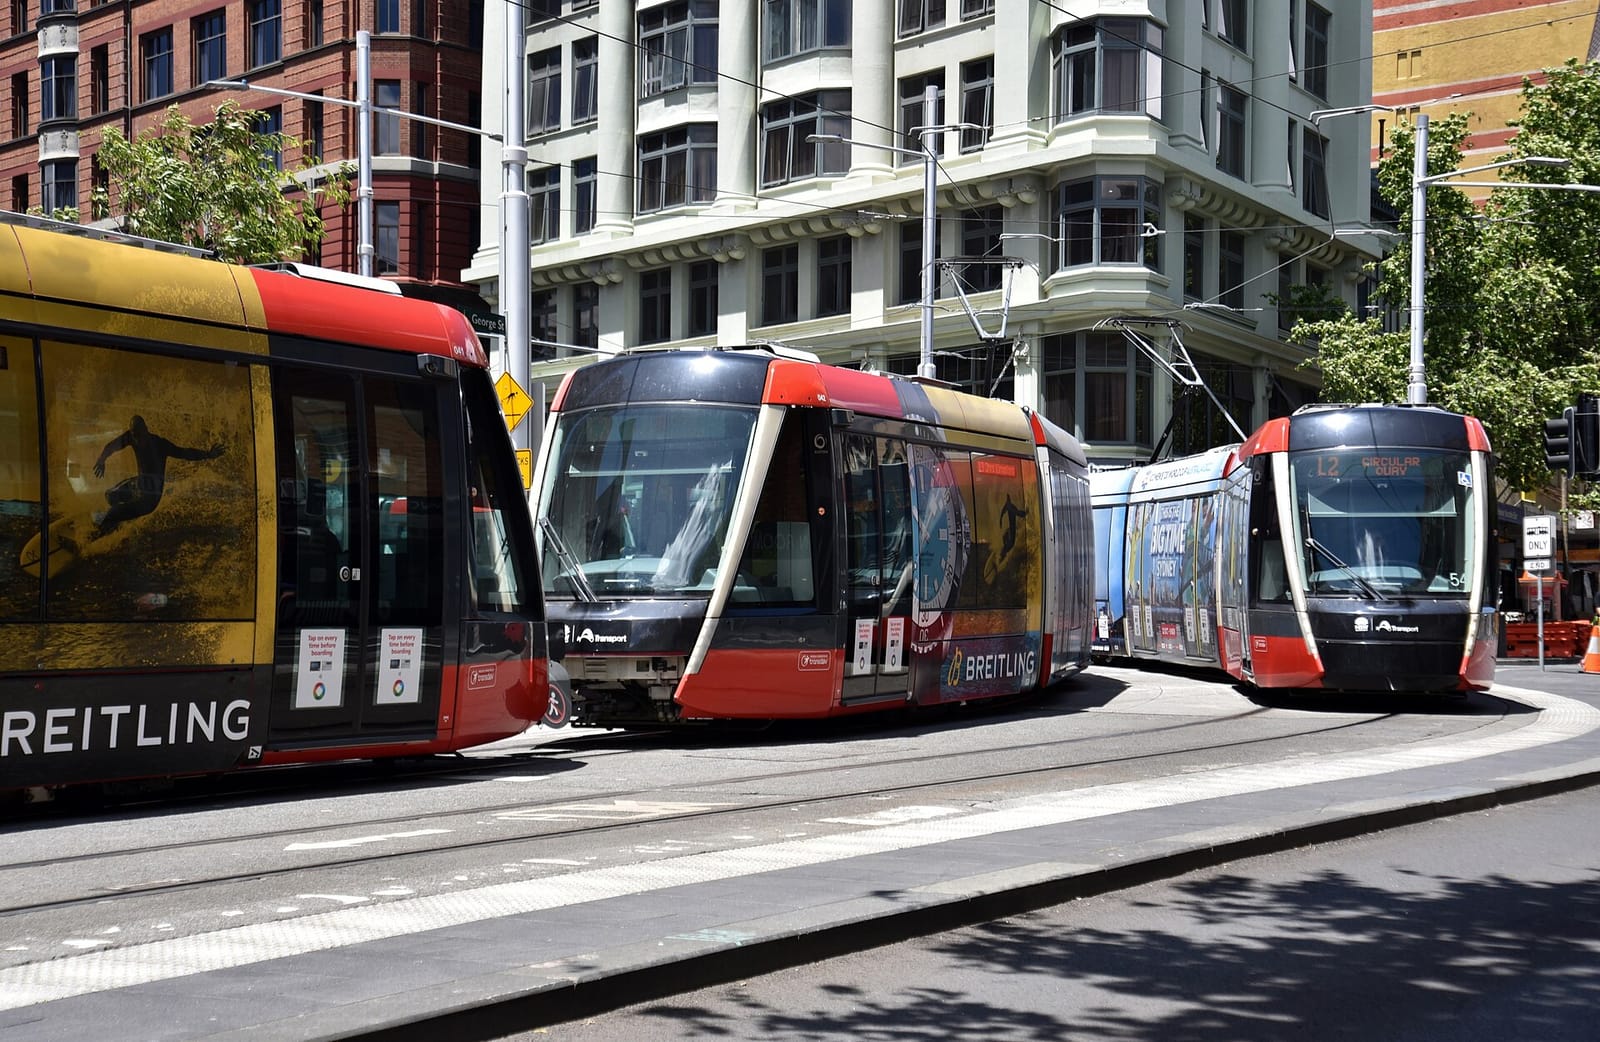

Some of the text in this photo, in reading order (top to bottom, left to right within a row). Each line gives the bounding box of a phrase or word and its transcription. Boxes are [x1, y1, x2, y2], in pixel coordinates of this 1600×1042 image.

[471, 314, 505, 330] George St
[453, 345, 464, 355] 041
[1316, 456, 1339, 477] L2
[1361, 456, 1421, 467] CIRCULAR
[1528, 541, 1548, 550] ONLY
[966, 651, 1035, 681] BREITLING
[1, 700, 251, 757] REITLING
